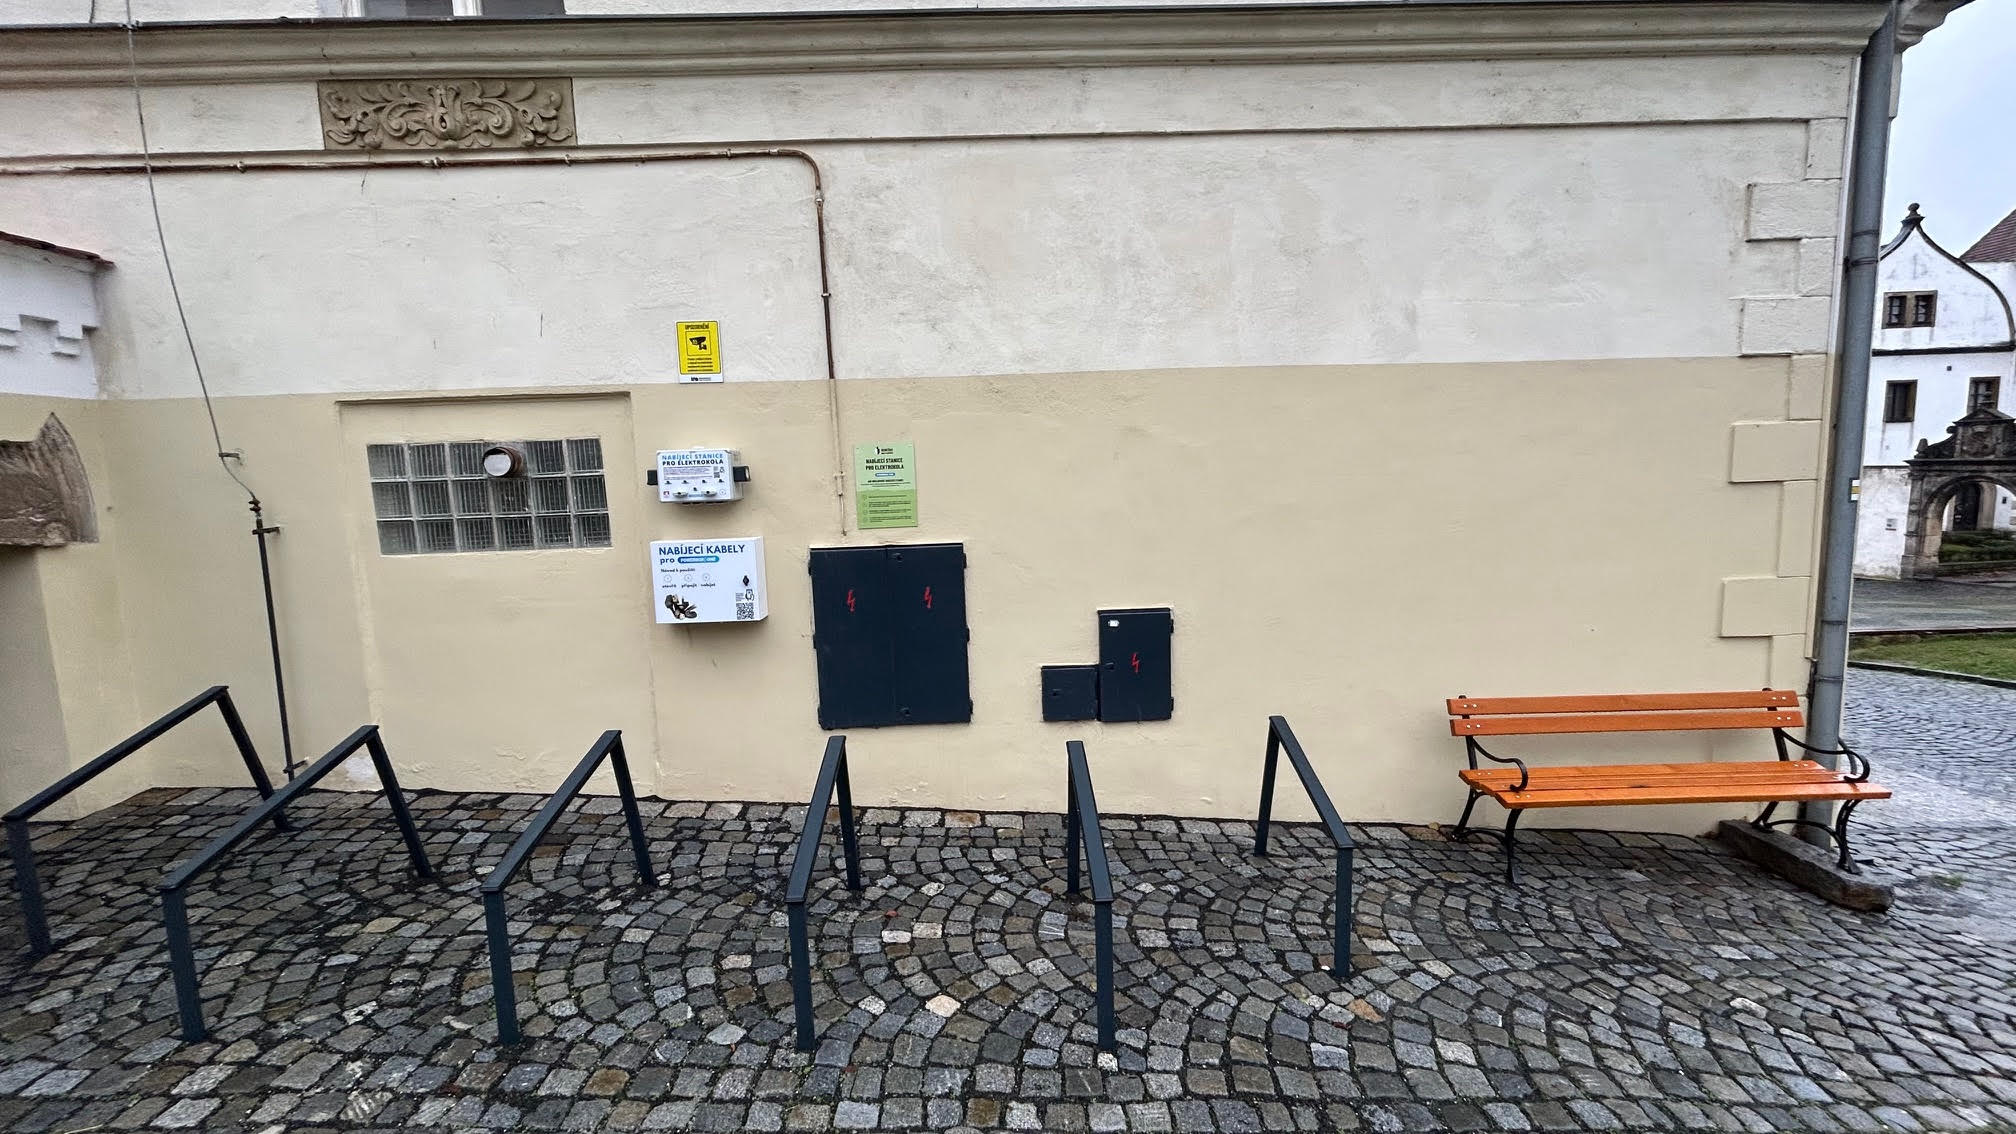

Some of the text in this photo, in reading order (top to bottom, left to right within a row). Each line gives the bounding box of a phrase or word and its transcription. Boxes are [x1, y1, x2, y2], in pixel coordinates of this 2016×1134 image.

[659, 544, 745, 555] NABÍJECÍ KABELY
[659, 557, 675, 565] pro
